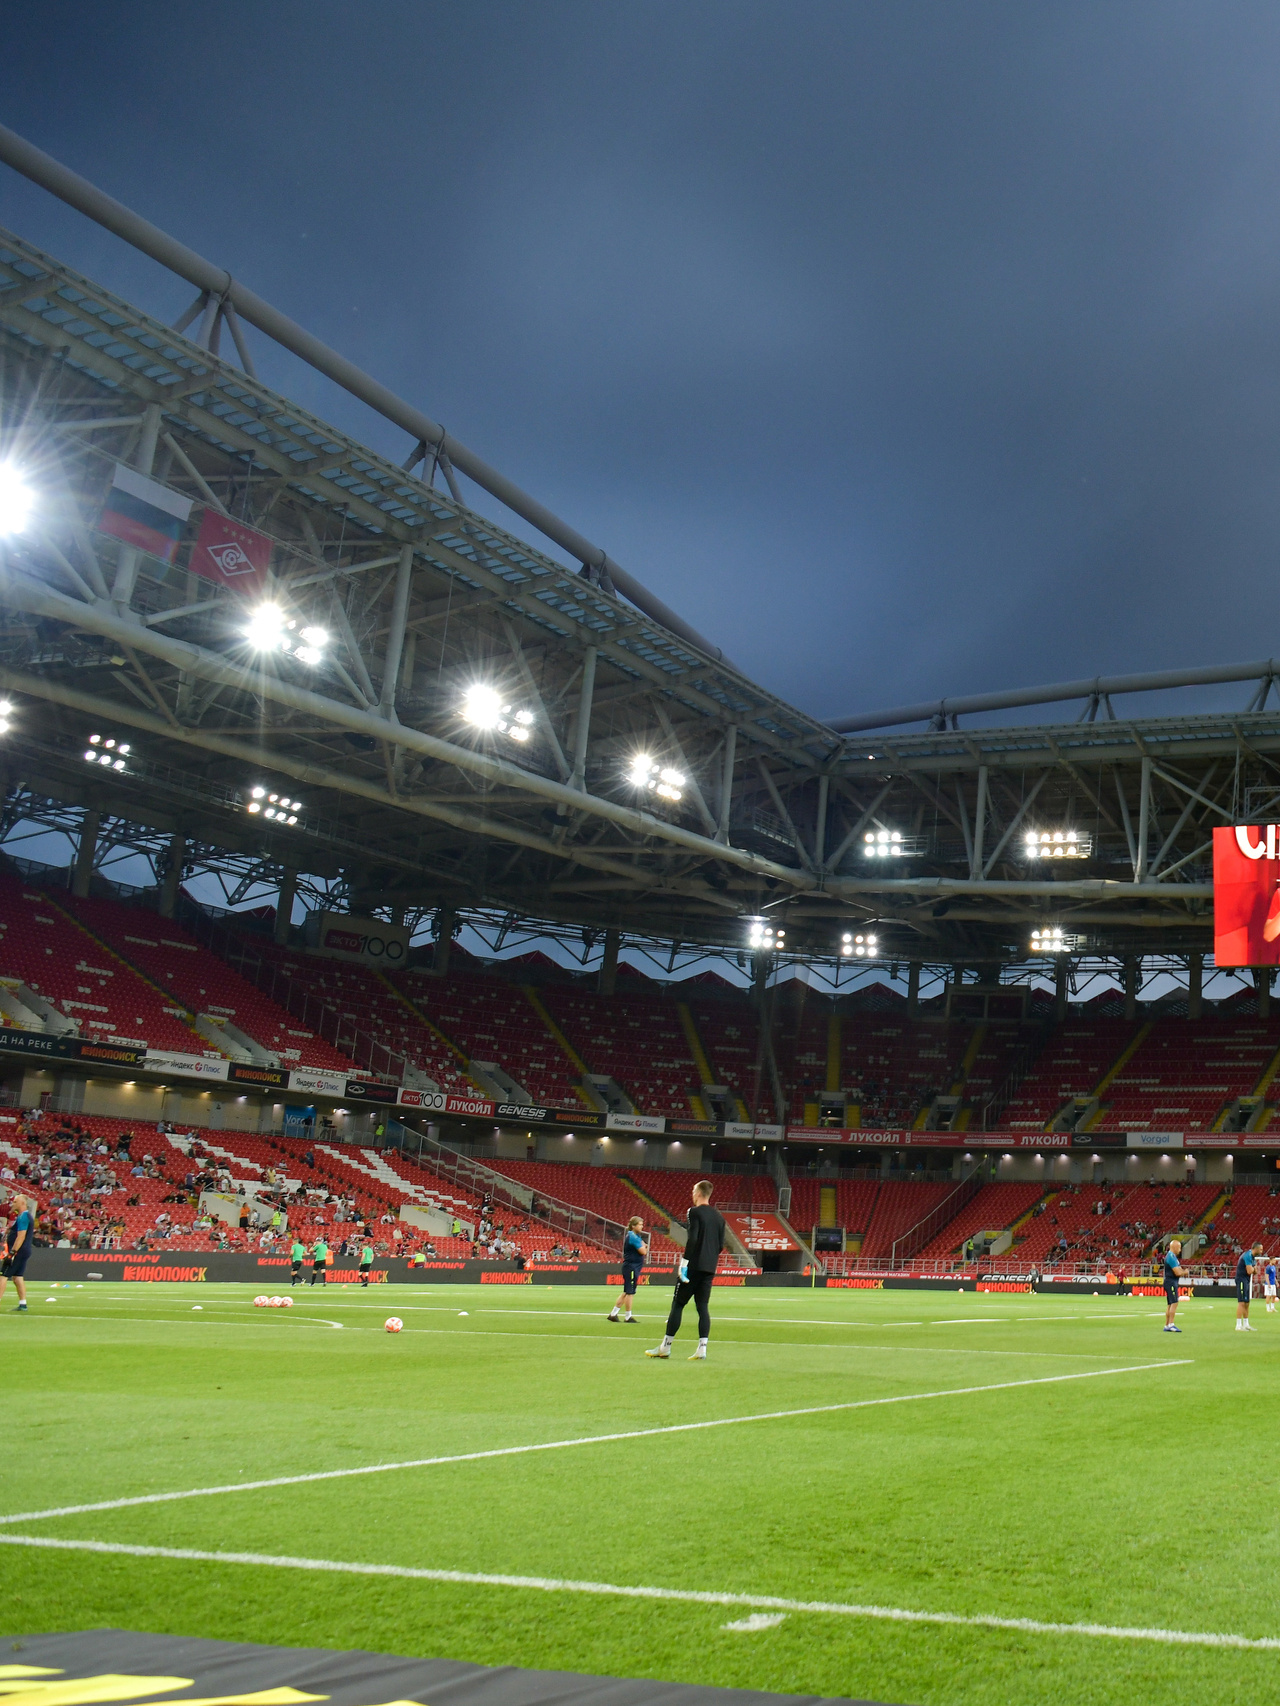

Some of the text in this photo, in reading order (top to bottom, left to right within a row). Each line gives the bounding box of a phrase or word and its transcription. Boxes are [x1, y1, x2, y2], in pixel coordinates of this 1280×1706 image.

[329, 935, 404, 959] ЭКТО 100
[11, 1037, 24, 1046] НА
[27, 1040, 53, 1050] РЕКЕ
[81, 1045, 137, 1063] КИНОПОИСК
[203, 1063, 221, 1074] Плюс
[235, 1069, 282, 1084] КИНОПОИСК
[296, 1078, 339, 1091] Яндекс Плюс
[419, 1092, 443, 1108] 100
[448, 1100, 492, 1115] ЛУКОЙЛ
[498, 1104, 547, 1118] GENESIS
[556, 1113, 599, 1124] КИНОПОИСК
[614, 1118, 658, 1129] Яндекс Плюс
[671, 1122, 717, 1132] КИНОПОИСК
[761, 1128, 778, 1136] Плюс
[849, 1131, 899, 1143] ЛУКОЙЛ
[1021, 1133, 1068, 1145] ЛУКОЙЛ
[1141, 1134, 1170, 1145] Vorgol
[748, 1242, 792, 1250] BET
[123, 1266, 207, 1281] КИНОПОИСК
[325, 1269, 389, 1283] КИНОИСК
[480, 1271, 533, 1285] КИНОПОИСК
[827, 1278, 884, 1289] КИНОПОИСК
[1132, 1285, 1194, 1297] КИНОИСК
